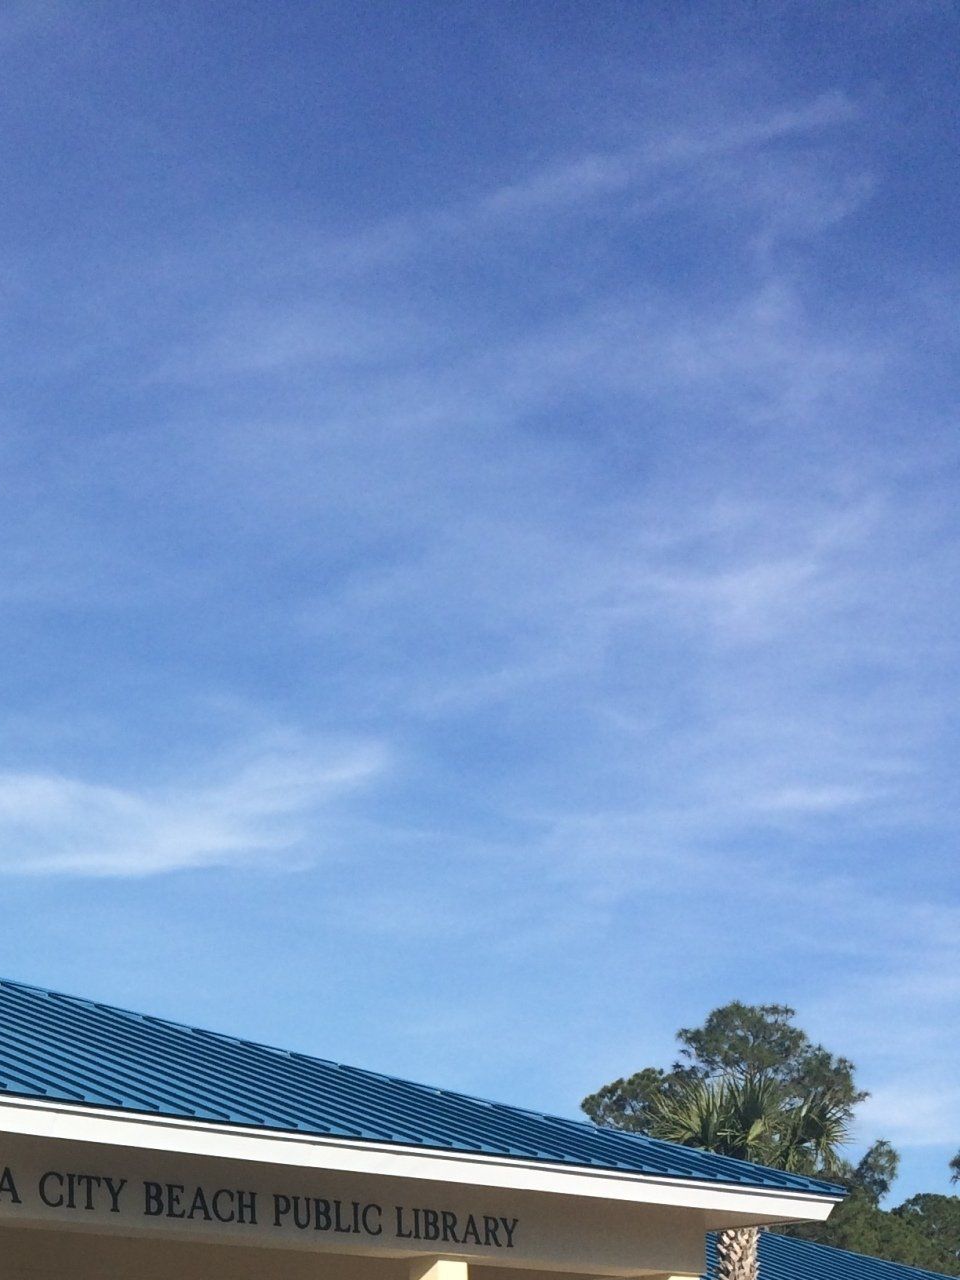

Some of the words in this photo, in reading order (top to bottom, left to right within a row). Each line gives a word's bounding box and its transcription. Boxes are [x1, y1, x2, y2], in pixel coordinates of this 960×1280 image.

[39, 1171, 127, 1213] CITY
[143, 1181, 258, 1225] BEACH
[272, 1193, 383, 1236] PUBLIC
[395, 1206, 519, 1248] LIBRARY
